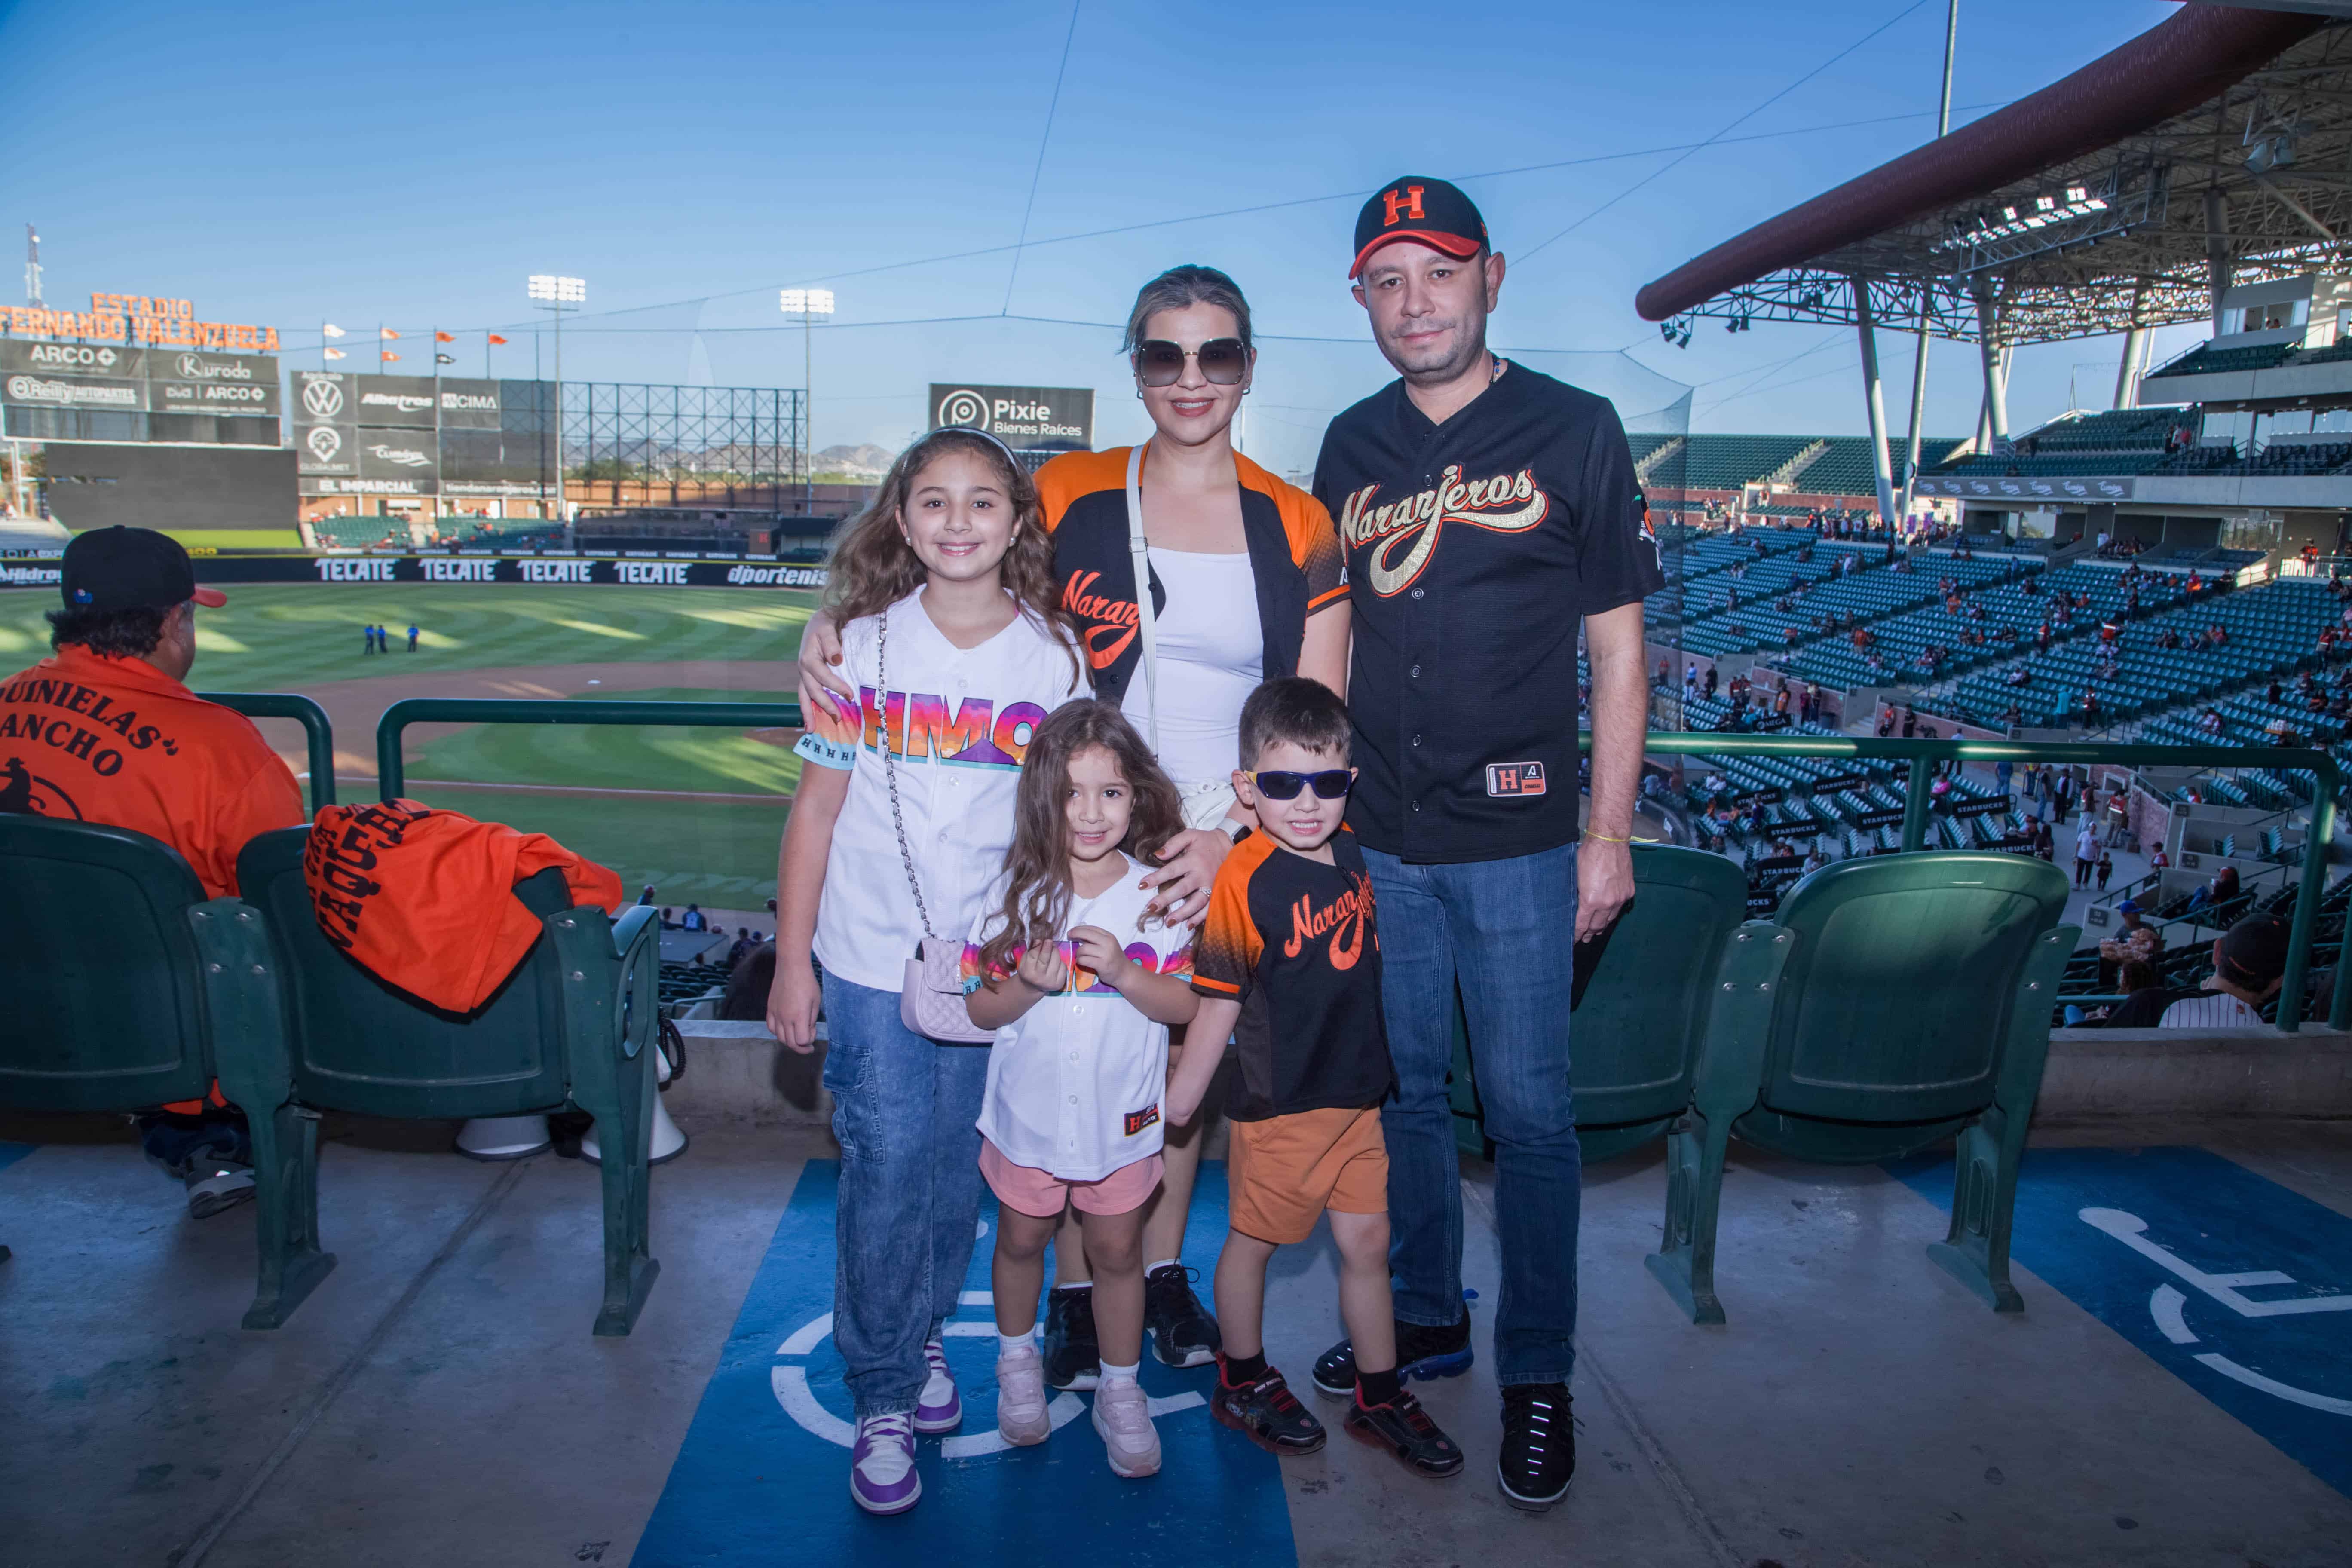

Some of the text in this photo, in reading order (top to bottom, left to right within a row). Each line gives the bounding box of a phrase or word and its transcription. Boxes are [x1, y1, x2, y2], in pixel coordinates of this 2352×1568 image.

[1384, 186, 1424, 226] H
[91, 292, 193, 319] ESTADIO
[0, 306, 280, 350] FERNANDO VALENZUELA
[31, 344, 95, 364] ARCO
[176, 353, 252, 379] Kuroda
[206, 387, 250, 400] ARCO
[361, 393, 434, 411] Albatros
[457, 395, 497, 409] CIMA
[994, 399, 1051, 420] Pixie
[994, 422, 1082, 436] Bienes Raíces
[319, 480, 418, 493] EL IMPARCIAL
[1340, 463, 1549, 598] Naranjeros
[315, 558, 401, 581] TECATE
[418, 559, 501, 581] TECATE
[516, 559, 597, 582] TECATE
[613, 561, 693, 584] TECATE
[860, 686, 1049, 772] HMO
[1499, 769, 1518, 790] H
[1816, 779, 1856, 790] STARBUCKS
[1957, 802, 2003, 813] STARBUCKS
[1862, 814, 1903, 824] STARBUCK
[1770, 824, 1816, 836] STARBUCKS
[1129, 1115, 1141, 1132] H
